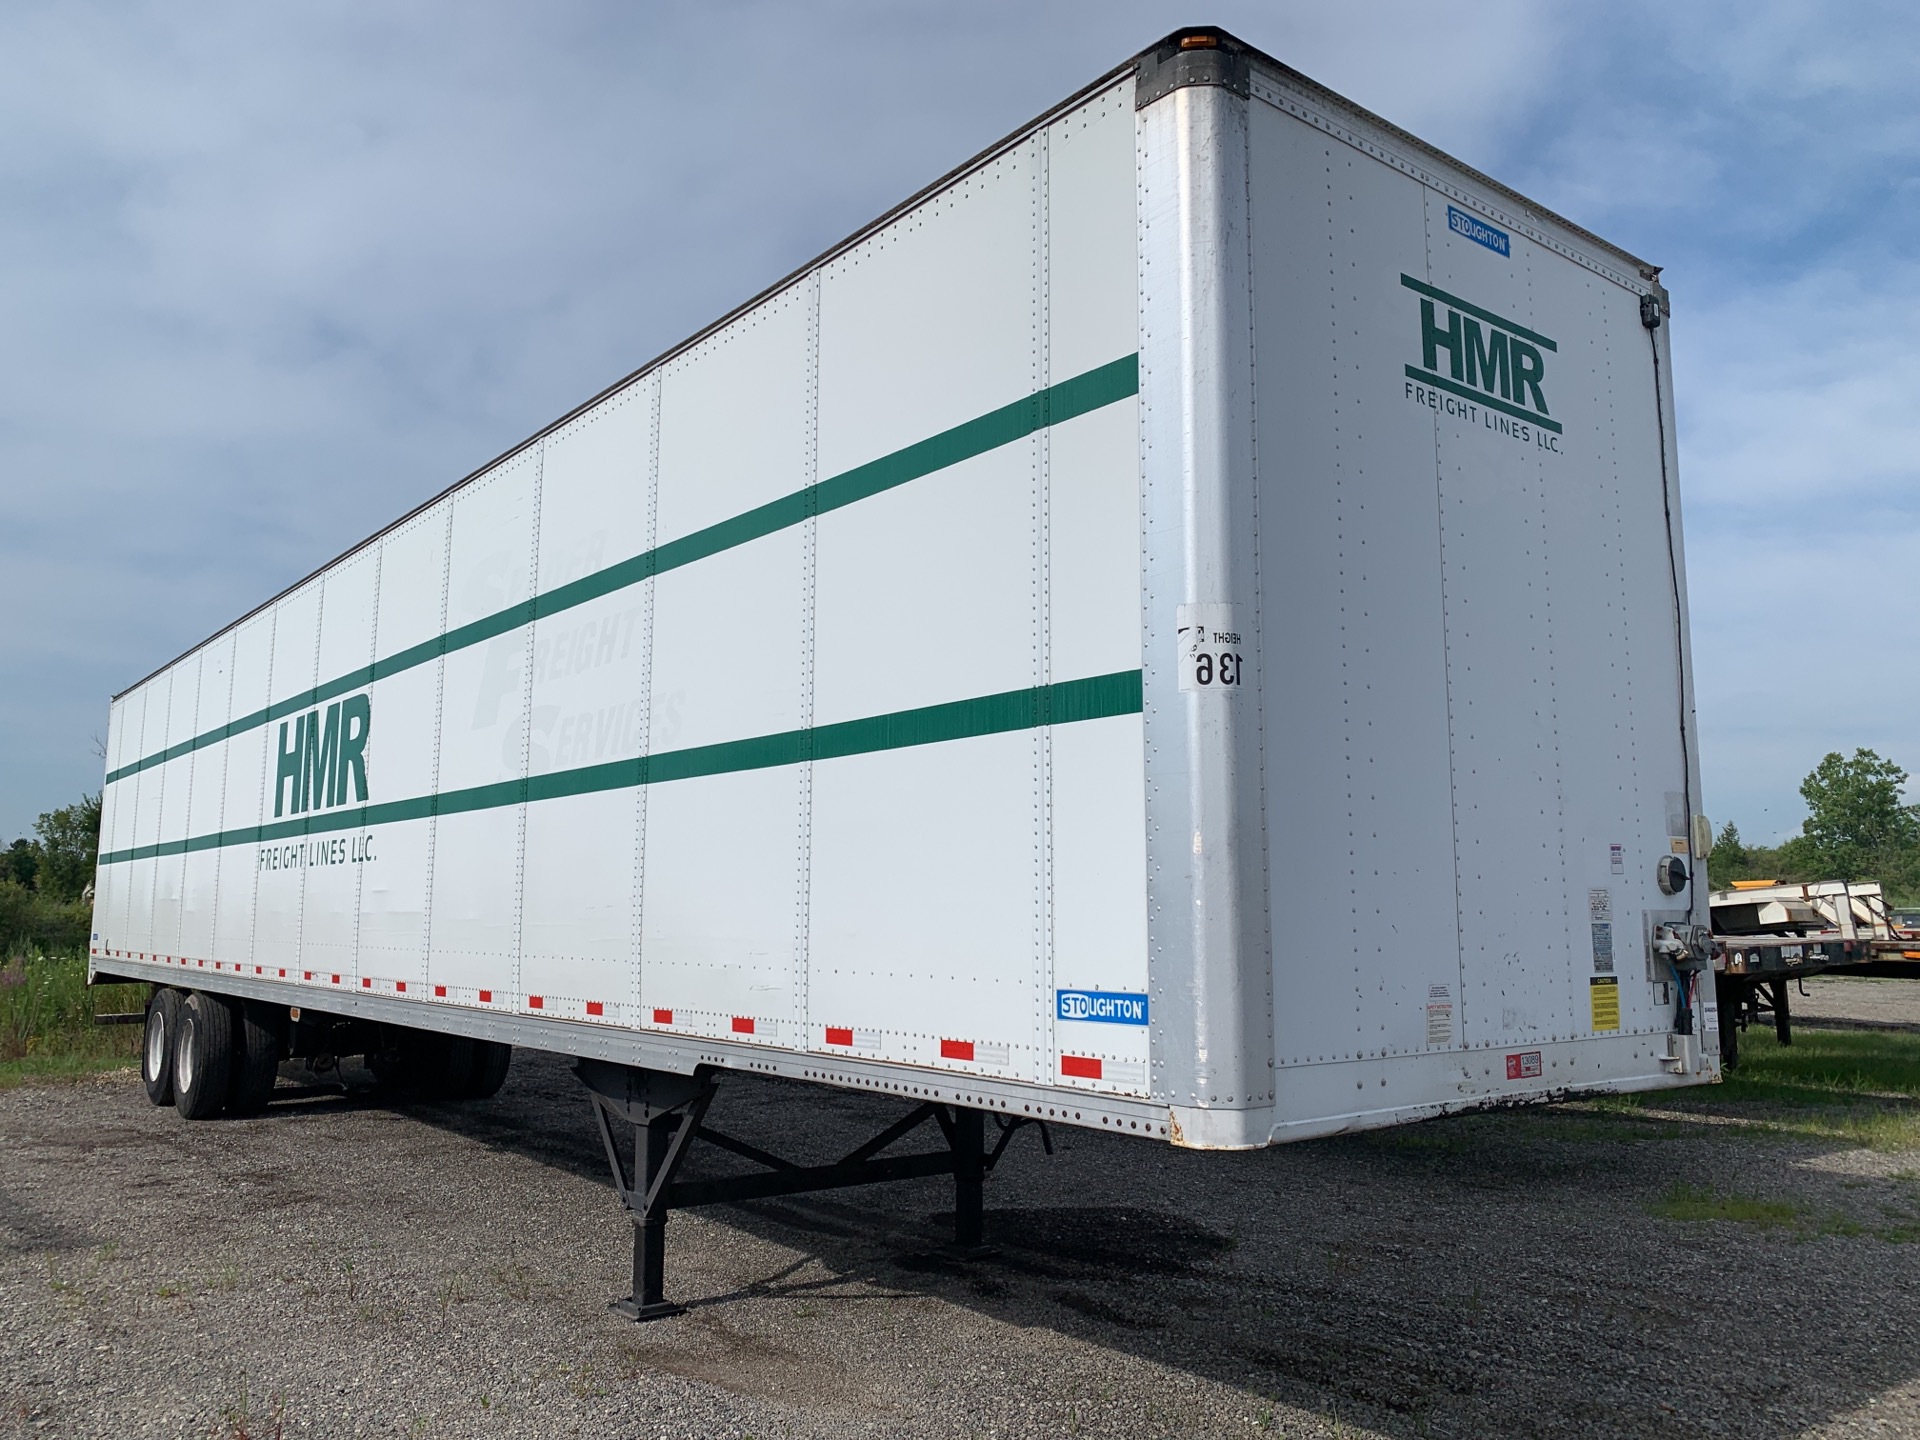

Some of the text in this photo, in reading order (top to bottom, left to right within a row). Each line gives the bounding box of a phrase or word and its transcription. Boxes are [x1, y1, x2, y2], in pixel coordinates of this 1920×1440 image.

[1451, 209, 1507, 252] STOUGHTON
[1420, 298, 1549, 415] HMR
[1405, 382, 1564, 455] FREIGHT LINES LLC.
[274, 693, 371, 818] HMR
[259, 834, 377, 871] FREIGHT LINES LLC.
[1061, 993, 1142, 1019] STOUGHTON
